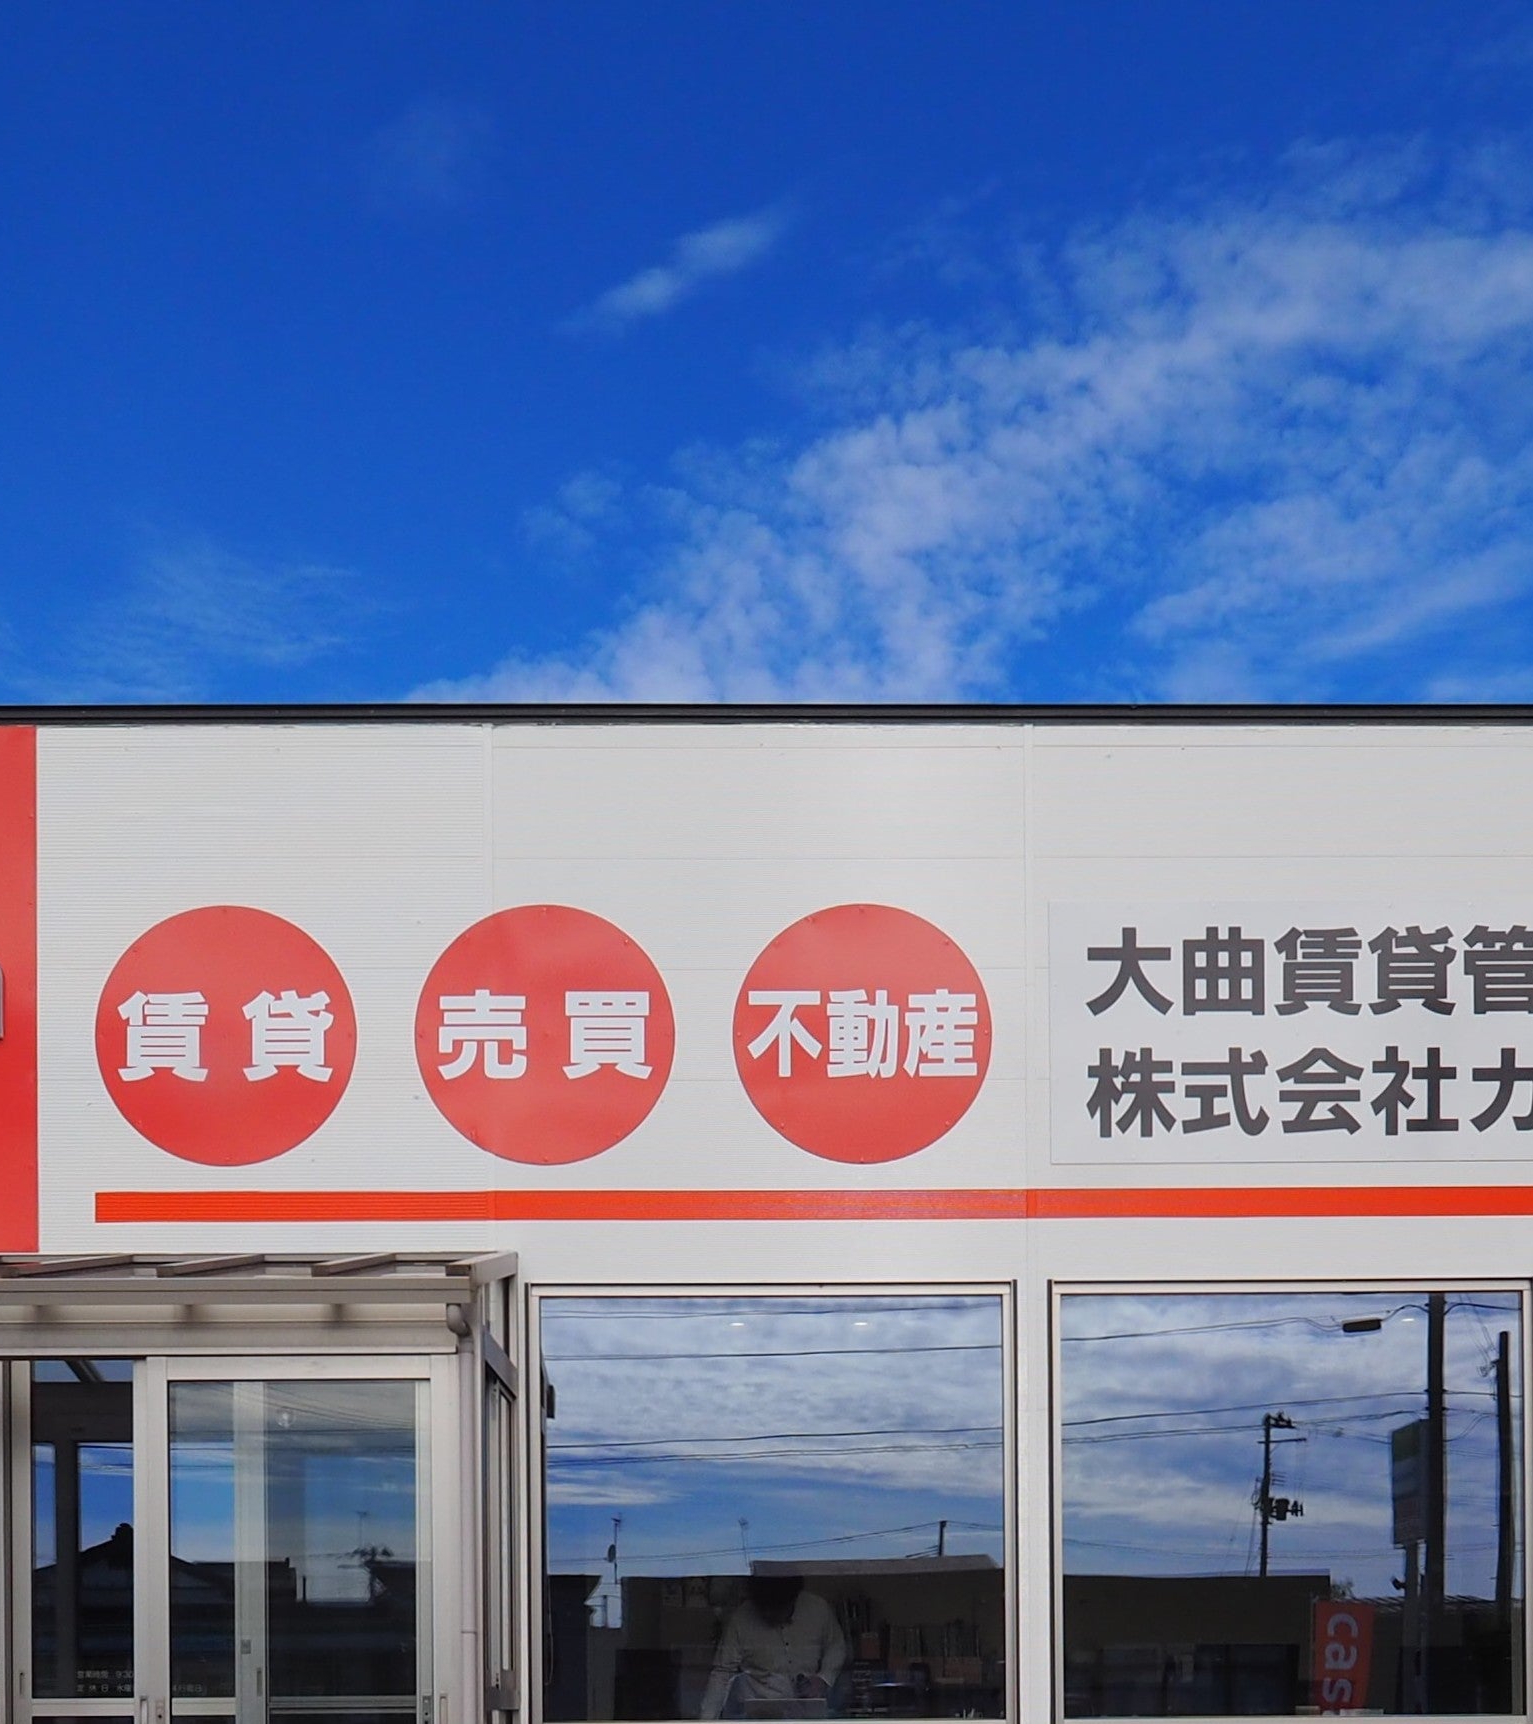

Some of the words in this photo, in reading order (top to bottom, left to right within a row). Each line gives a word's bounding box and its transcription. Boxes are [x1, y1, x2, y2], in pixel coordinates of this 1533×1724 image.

[117, 990, 335, 1082] 賃貸
[437, 989, 653, 1080] 売買
[747, 989, 979, 1079] 不動産
[1322, 1612, 1359, 1714] cas
